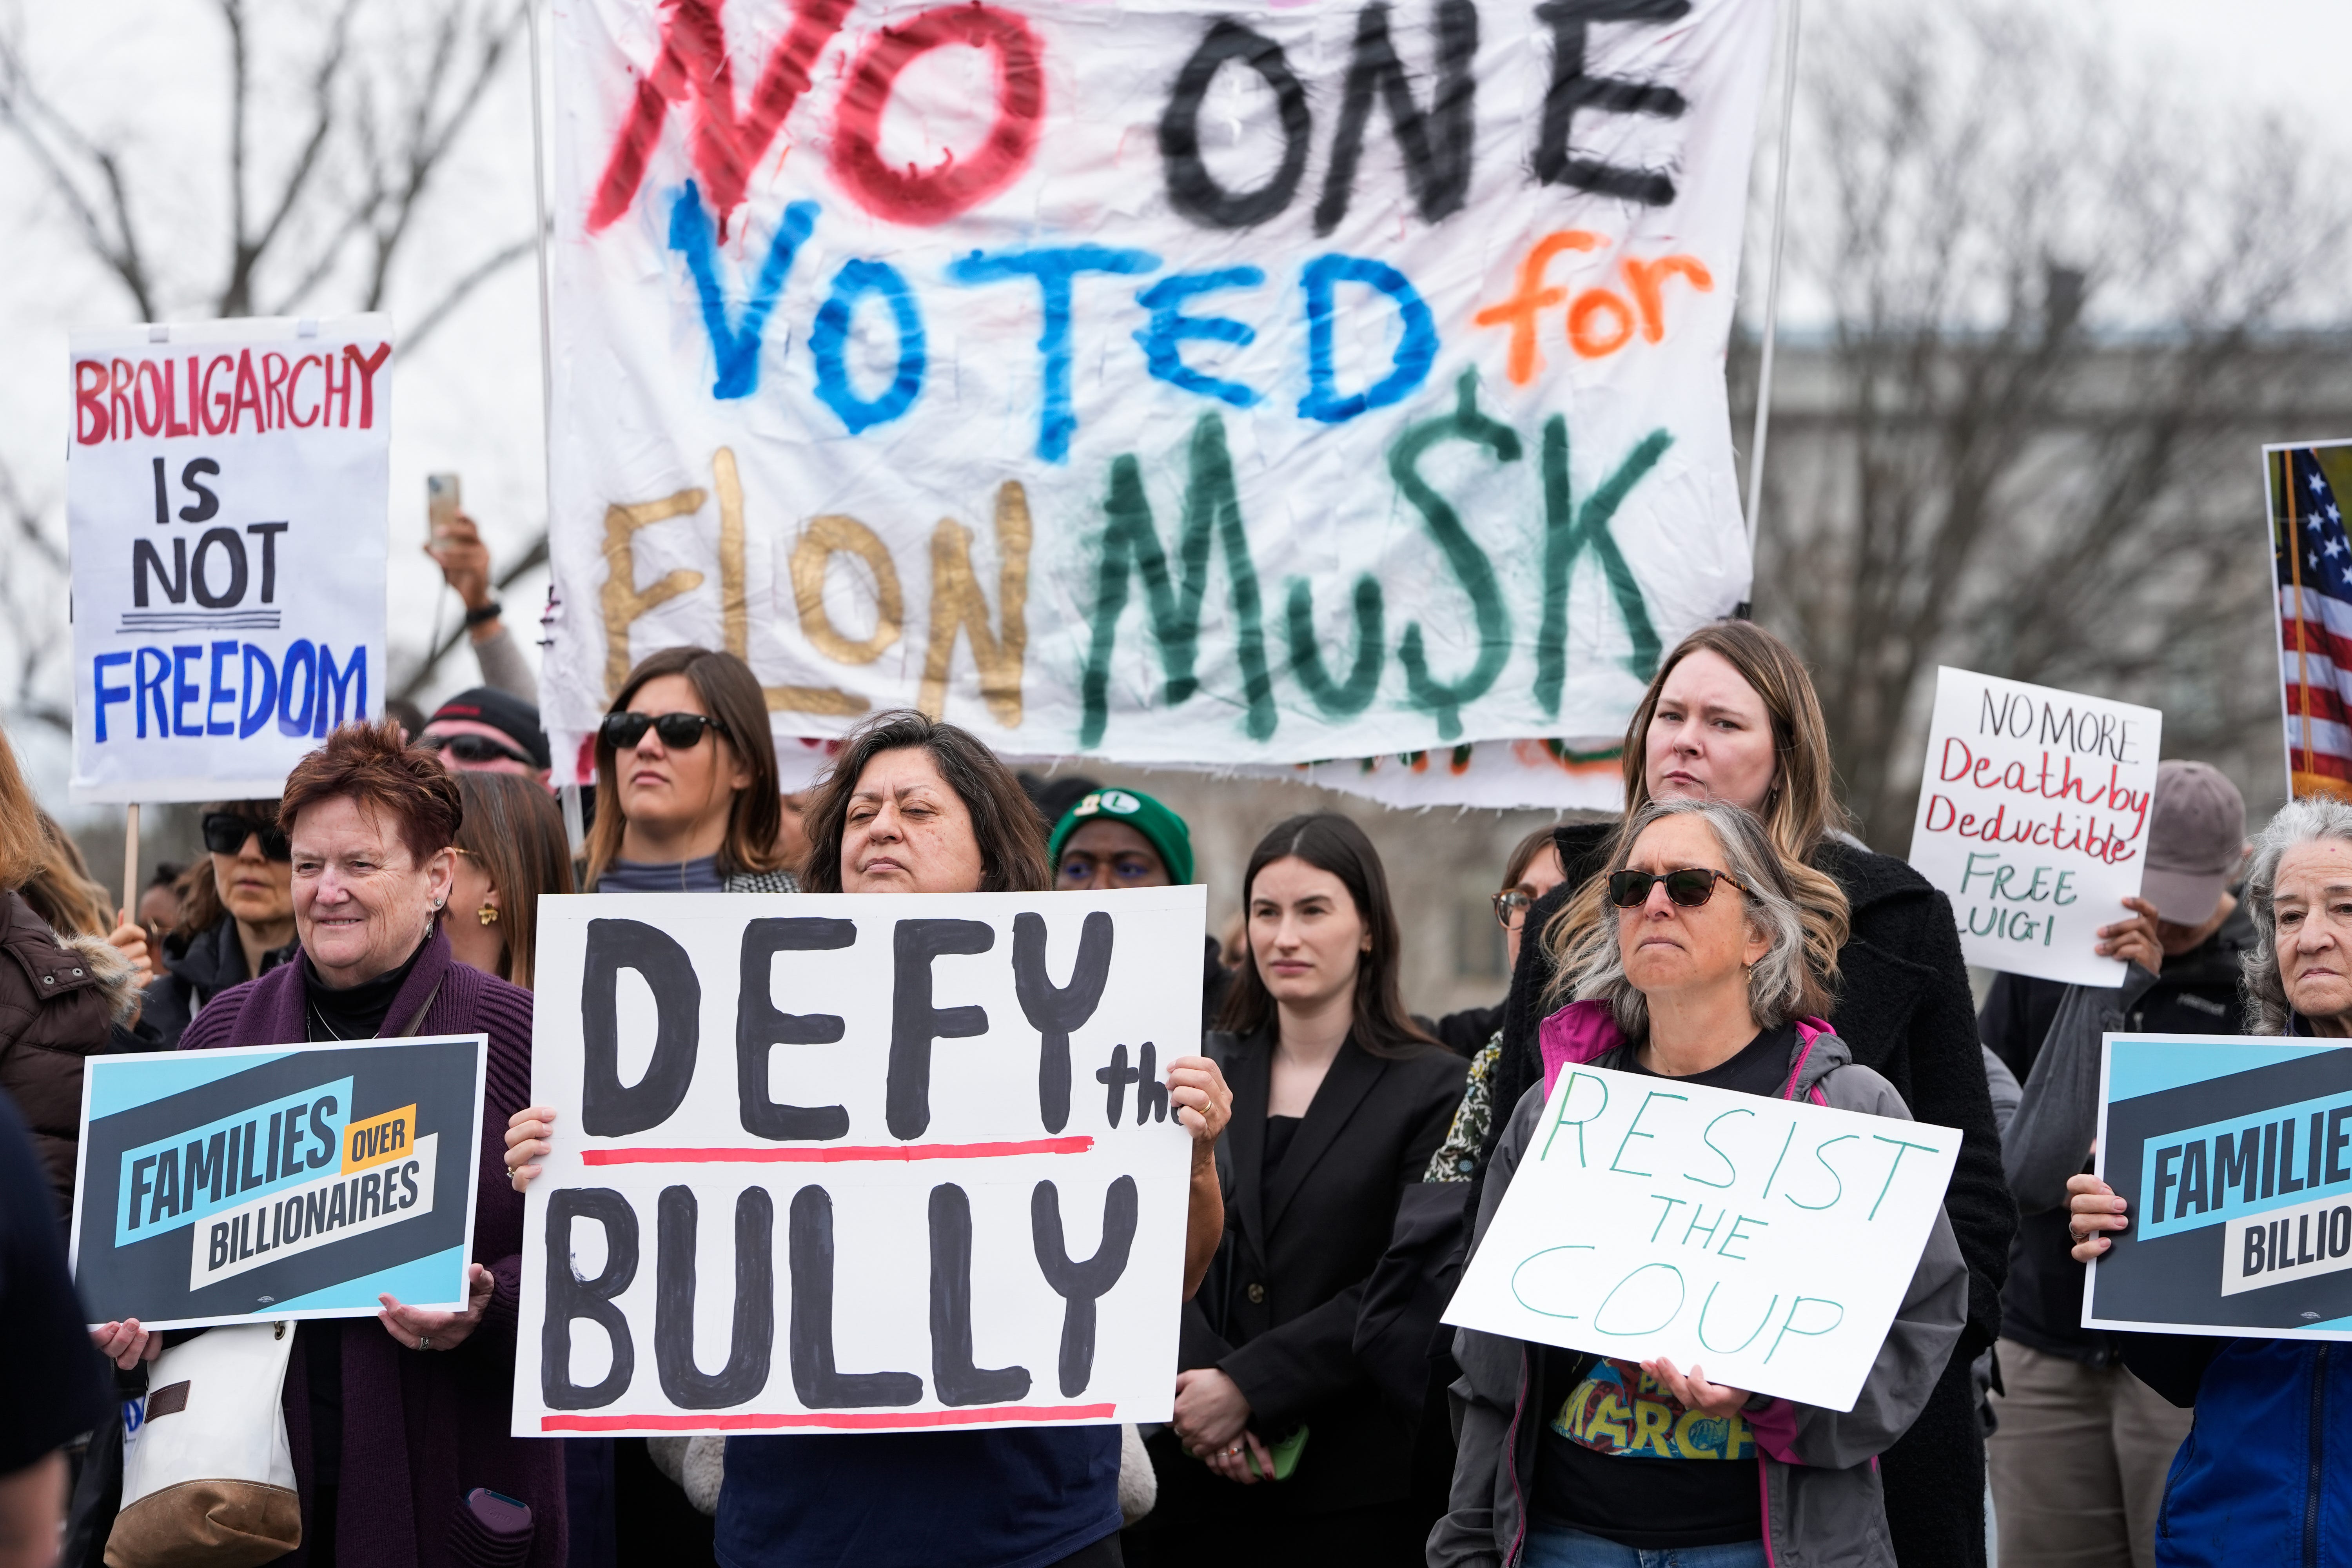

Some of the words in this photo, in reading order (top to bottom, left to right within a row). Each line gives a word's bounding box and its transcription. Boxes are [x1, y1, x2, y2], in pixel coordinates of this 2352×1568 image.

[586, 0, 1046, 244] NO
[1156, 0, 1692, 237] ONE
[667, 179, 1440, 464] VOTED
[1472, 230, 1714, 386] for
[75, 341, 391, 446] BROLIGARCHY
[153, 457, 220, 524] IS
[133, 522, 289, 608] NOT
[94, 639, 367, 743] FREEDOM
[1980, 688, 2033, 738] NO
[2040, 702, 2140, 764] MORE
[1926, 795, 2136, 864] Deductible
[1960, 852, 2077, 906] FREE
[1958, 907, 2054, 946] UIGI
[581, 911, 1114, 1141] DEFY
[1096, 1041, 1184, 1129] th
[127, 1095, 338, 1231] FAMILIES
[351, 1118, 405, 1162] OVER
[1541, 1072, 1939, 1221] RESIST
[208, 1160, 419, 1272] BILLIONAIRES
[1651, 1194, 1768, 1260] THE
[541, 1174, 1138, 1410] BULLY
[1512, 1245, 1844, 1364] COUP
